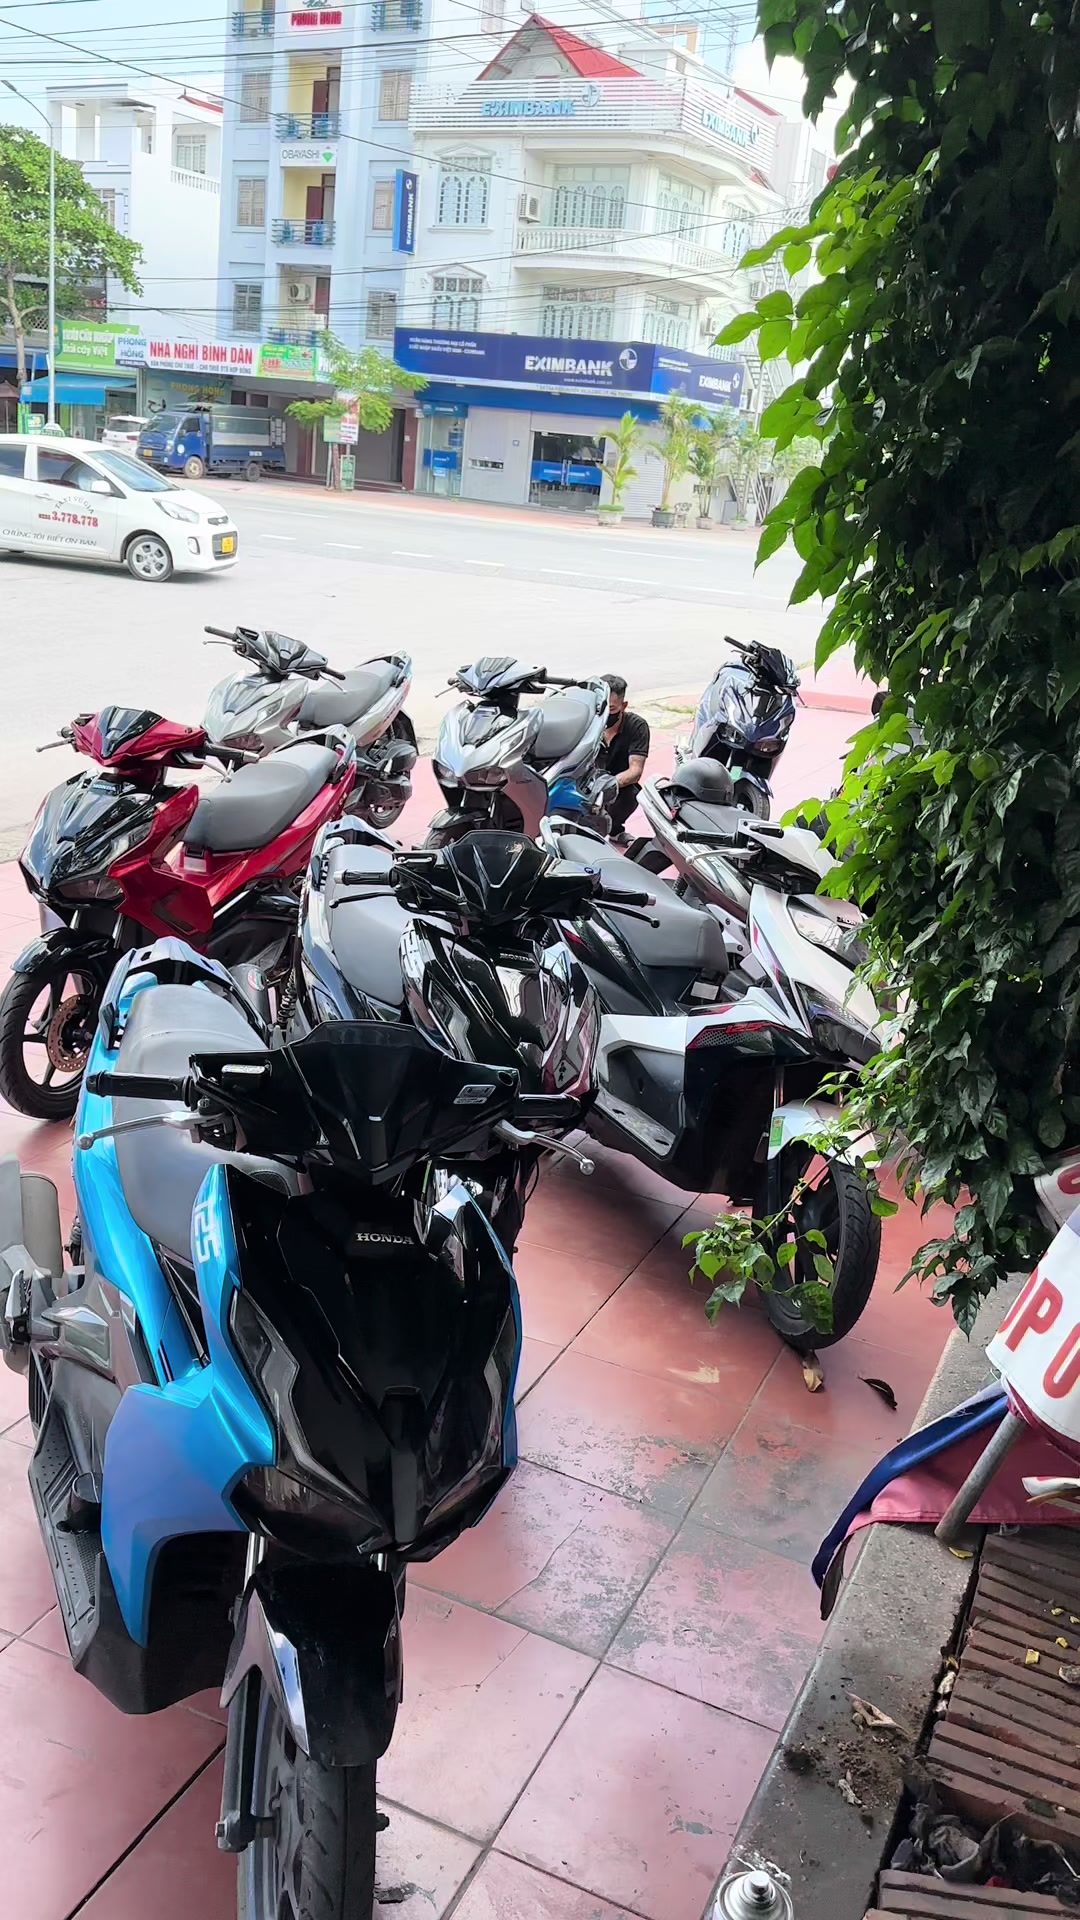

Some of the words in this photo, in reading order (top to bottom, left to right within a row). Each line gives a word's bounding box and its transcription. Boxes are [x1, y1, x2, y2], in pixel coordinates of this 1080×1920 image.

[481, 99, 576, 117] EXIMBANK
[700, 108, 749, 147] EXIMBANK
[281, 149, 320, 160] OBAYASHI
[406, 192, 414, 245] EXIMBANK
[150, 339, 171, 358] NHÀ
[174, 340, 199, 360] NGHỈ
[202, 341, 227, 362] BÌNH
[231, 344, 253, 364] DÂN
[524, 355, 614, 377] EXIMBANK
[699, 374, 732, 393] EXIMBANK
[194, 1199, 221, 1264] 125
[355, 1231, 416, 1246] HONDA
